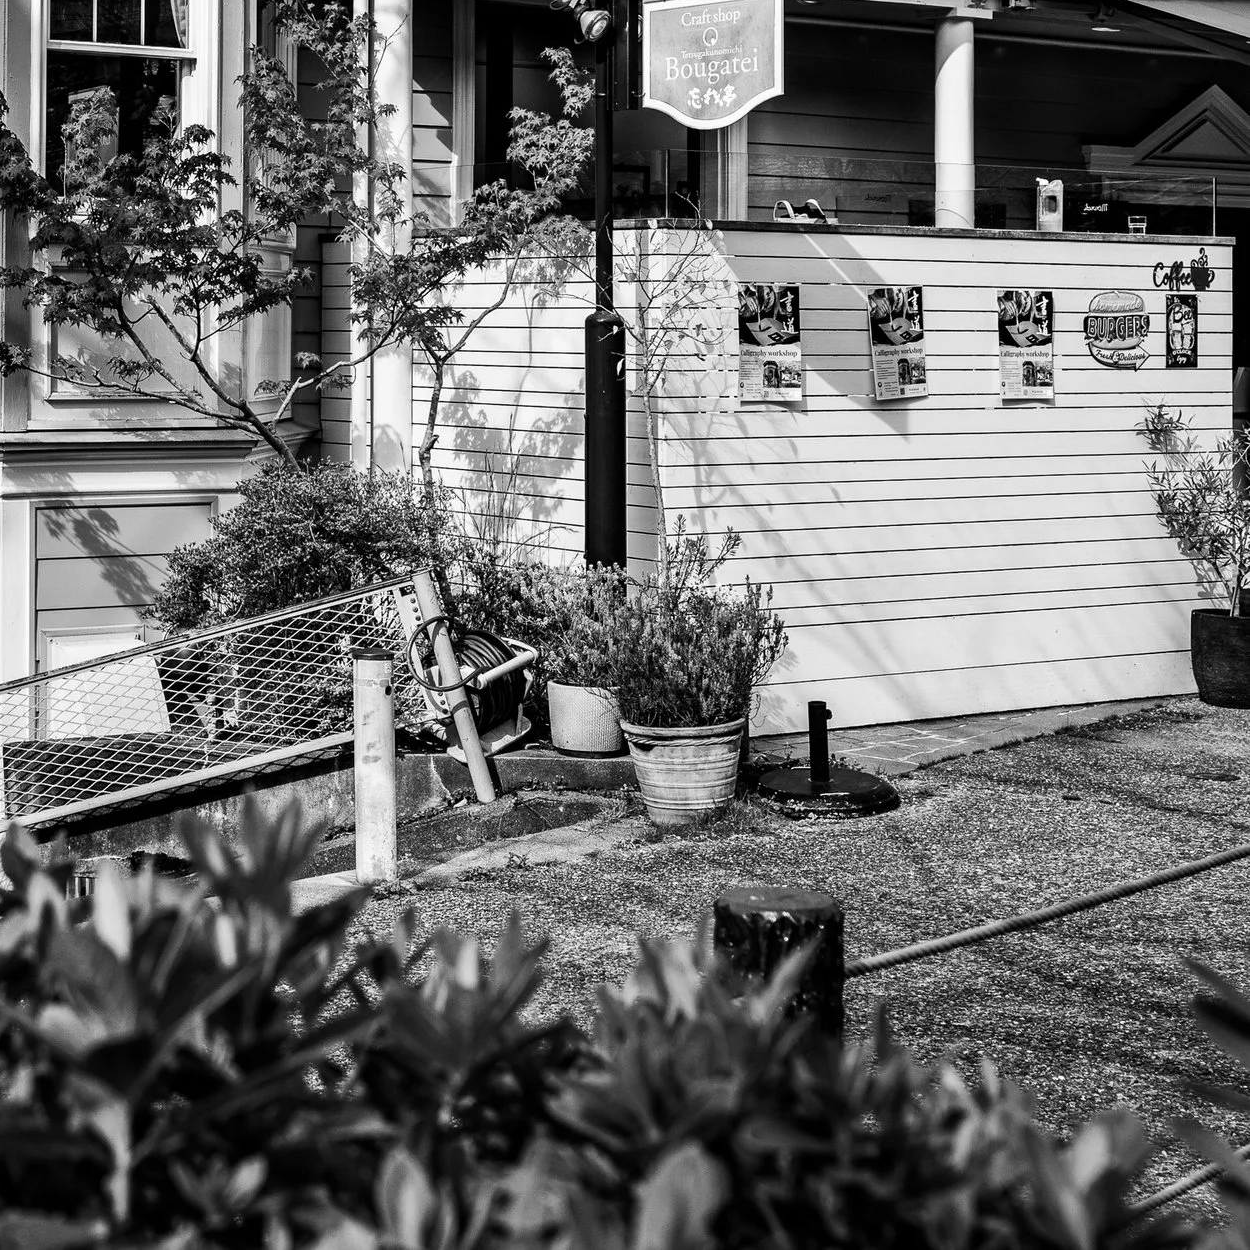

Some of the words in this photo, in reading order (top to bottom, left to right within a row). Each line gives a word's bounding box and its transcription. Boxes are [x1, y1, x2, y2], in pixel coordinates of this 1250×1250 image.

[681, 8, 711, 26] Craft
[713, 7, 741, 25] shop
[664, 48, 759, 85] Bougatei
[1153, 262, 1191, 291] Coffee
[1091, 297, 1142, 311] homemade
[1088, 315, 1147, 340] BURGERS
[768, 349, 798, 358] workshop
[901, 347, 923, 355] workshop
[1026, 350, 1050, 358] workshop
[1118, 352, 1146, 362] Delicious
